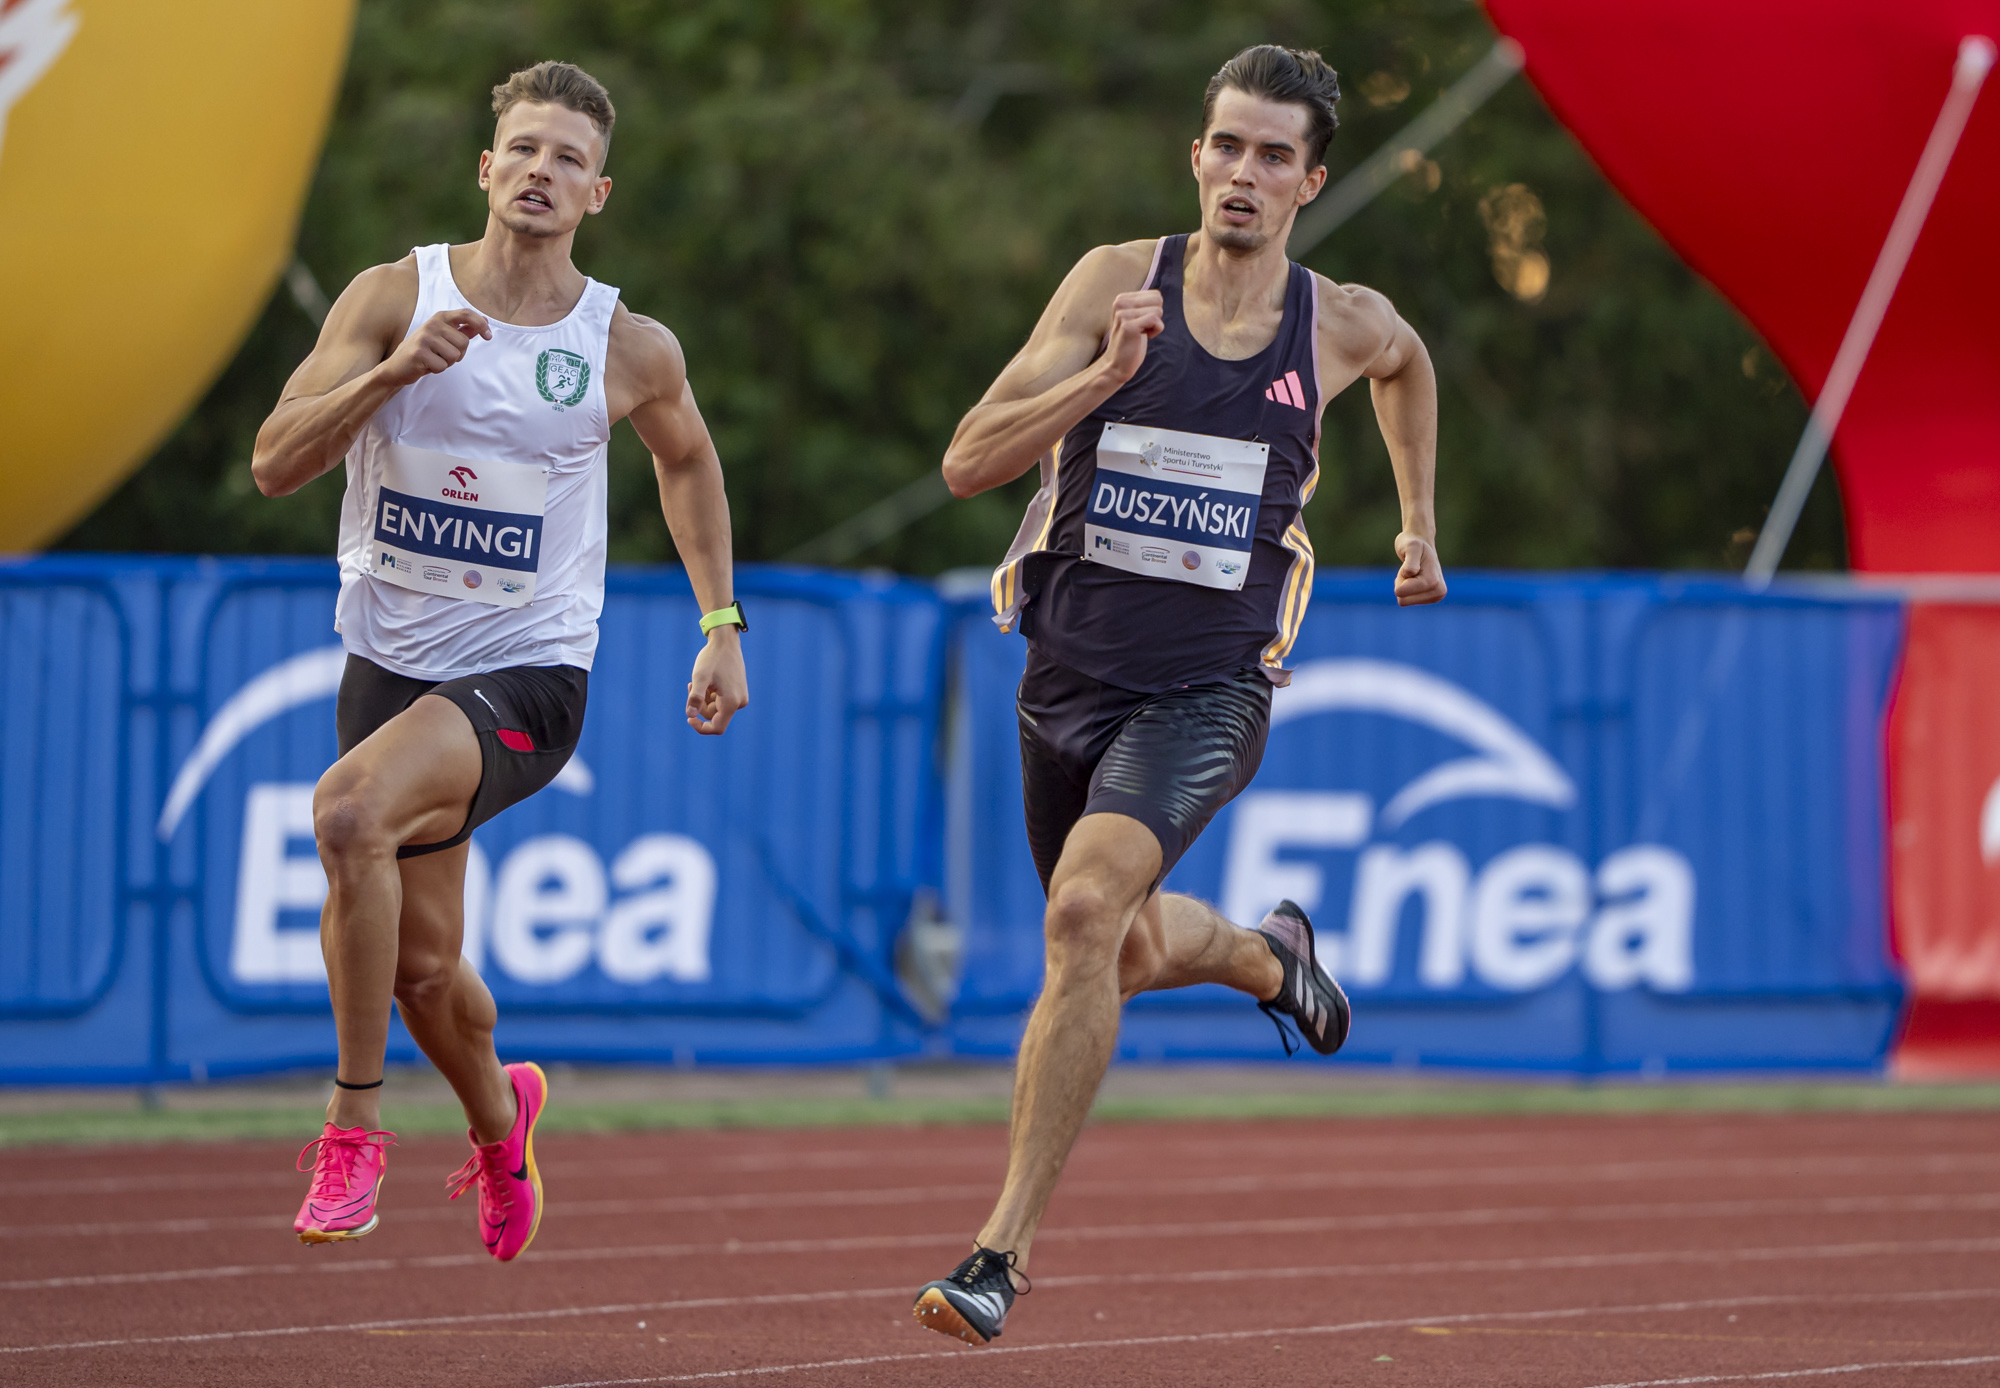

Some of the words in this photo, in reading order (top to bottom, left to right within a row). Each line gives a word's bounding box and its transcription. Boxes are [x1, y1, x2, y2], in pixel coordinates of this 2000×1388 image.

[550, 364, 577, 377] GEAC
[1163, 446, 1211, 461] Ministerstwo
[1162, 455, 1187, 468] Sportu
[1191, 459, 1224, 472] Turystyki
[442, 488, 479, 502] ORLEN
[1093, 483, 1251, 539] DUSZYŃSKI
[380, 501, 534, 559] ENYINGI
[1221, 790, 1696, 993] Enea
